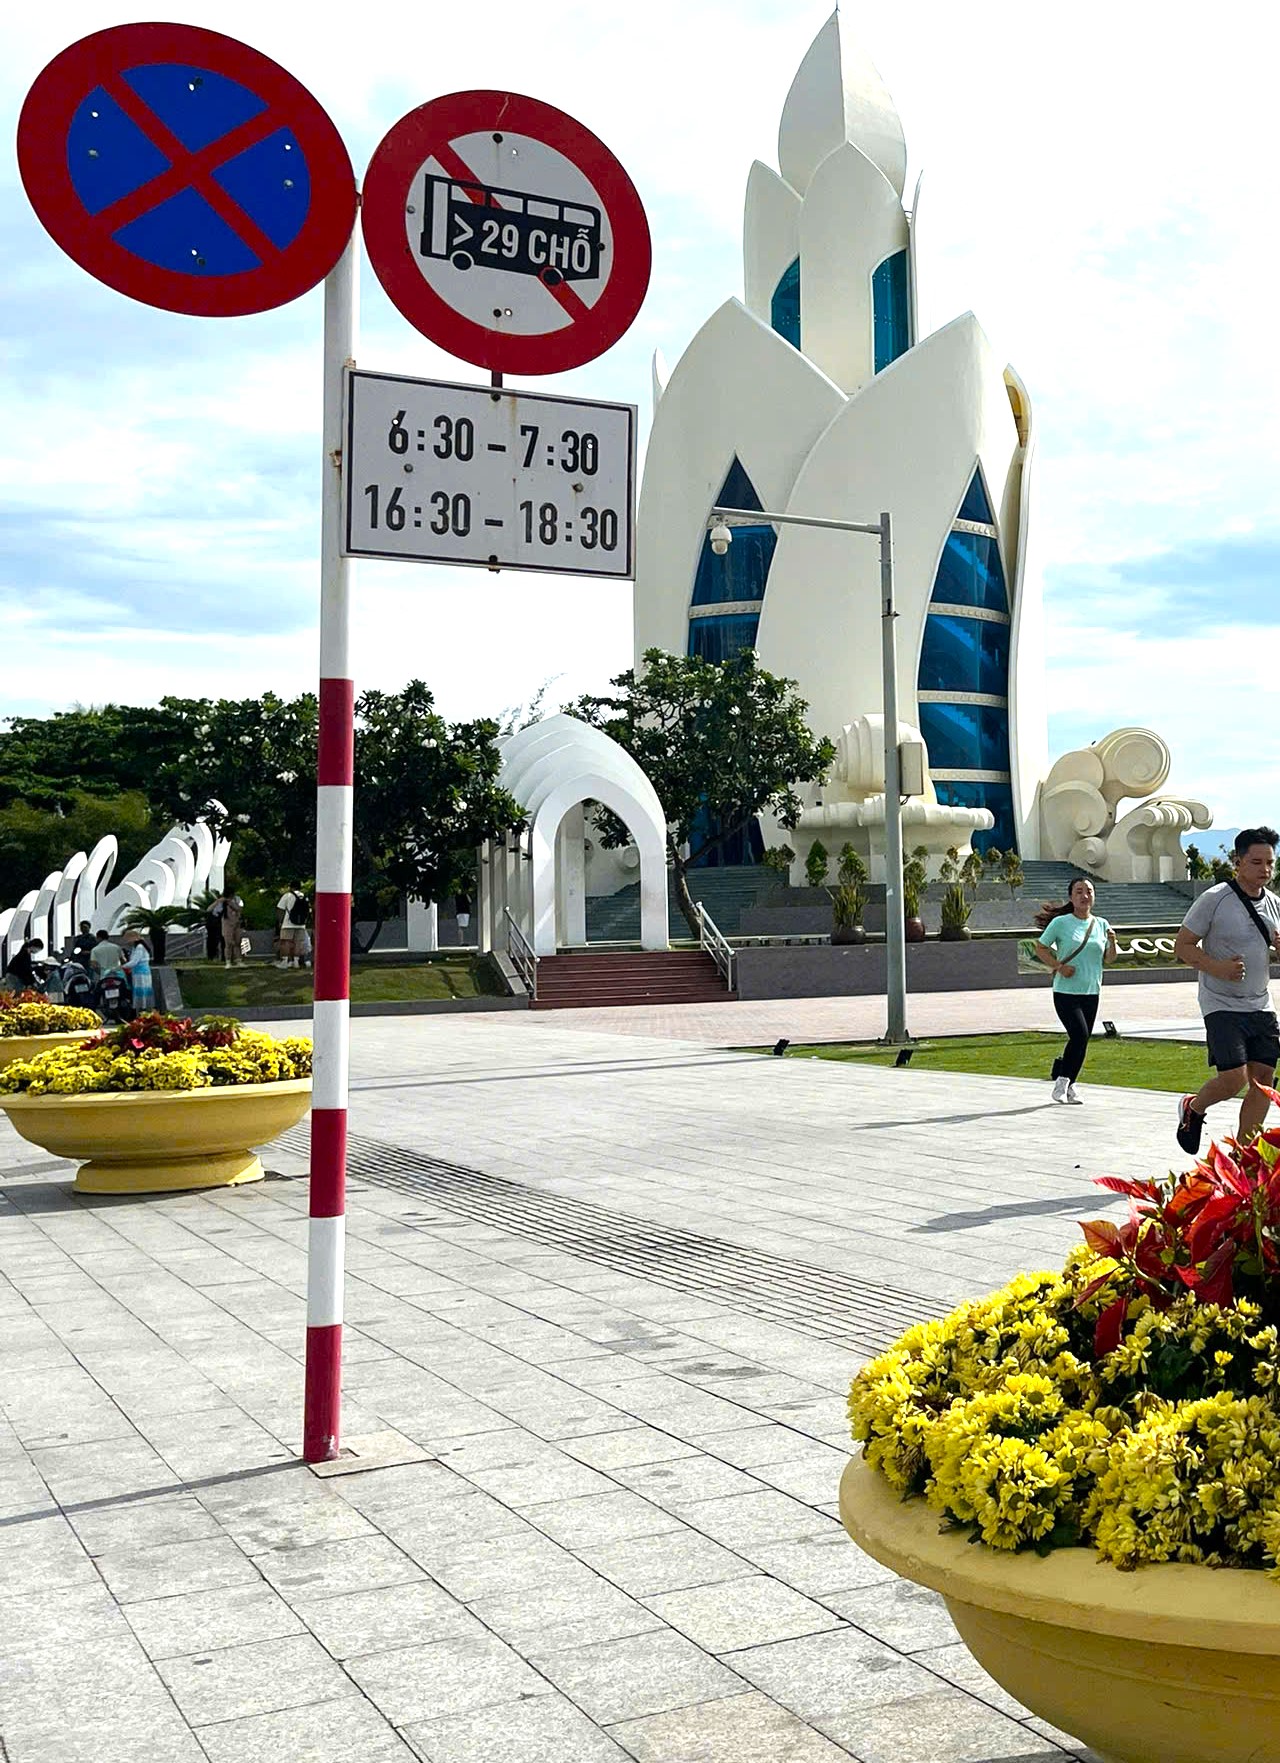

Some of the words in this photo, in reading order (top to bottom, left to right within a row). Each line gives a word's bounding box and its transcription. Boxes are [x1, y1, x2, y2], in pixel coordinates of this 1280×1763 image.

[480, 219, 520, 259] 29
[528, 227, 592, 273] CHỖ
[388, 410, 474, 462] 6:30
[520, 424, 599, 476] 7:30
[364, 484, 471, 537] 16:30
[519, 500, 618, 551] 18:30
